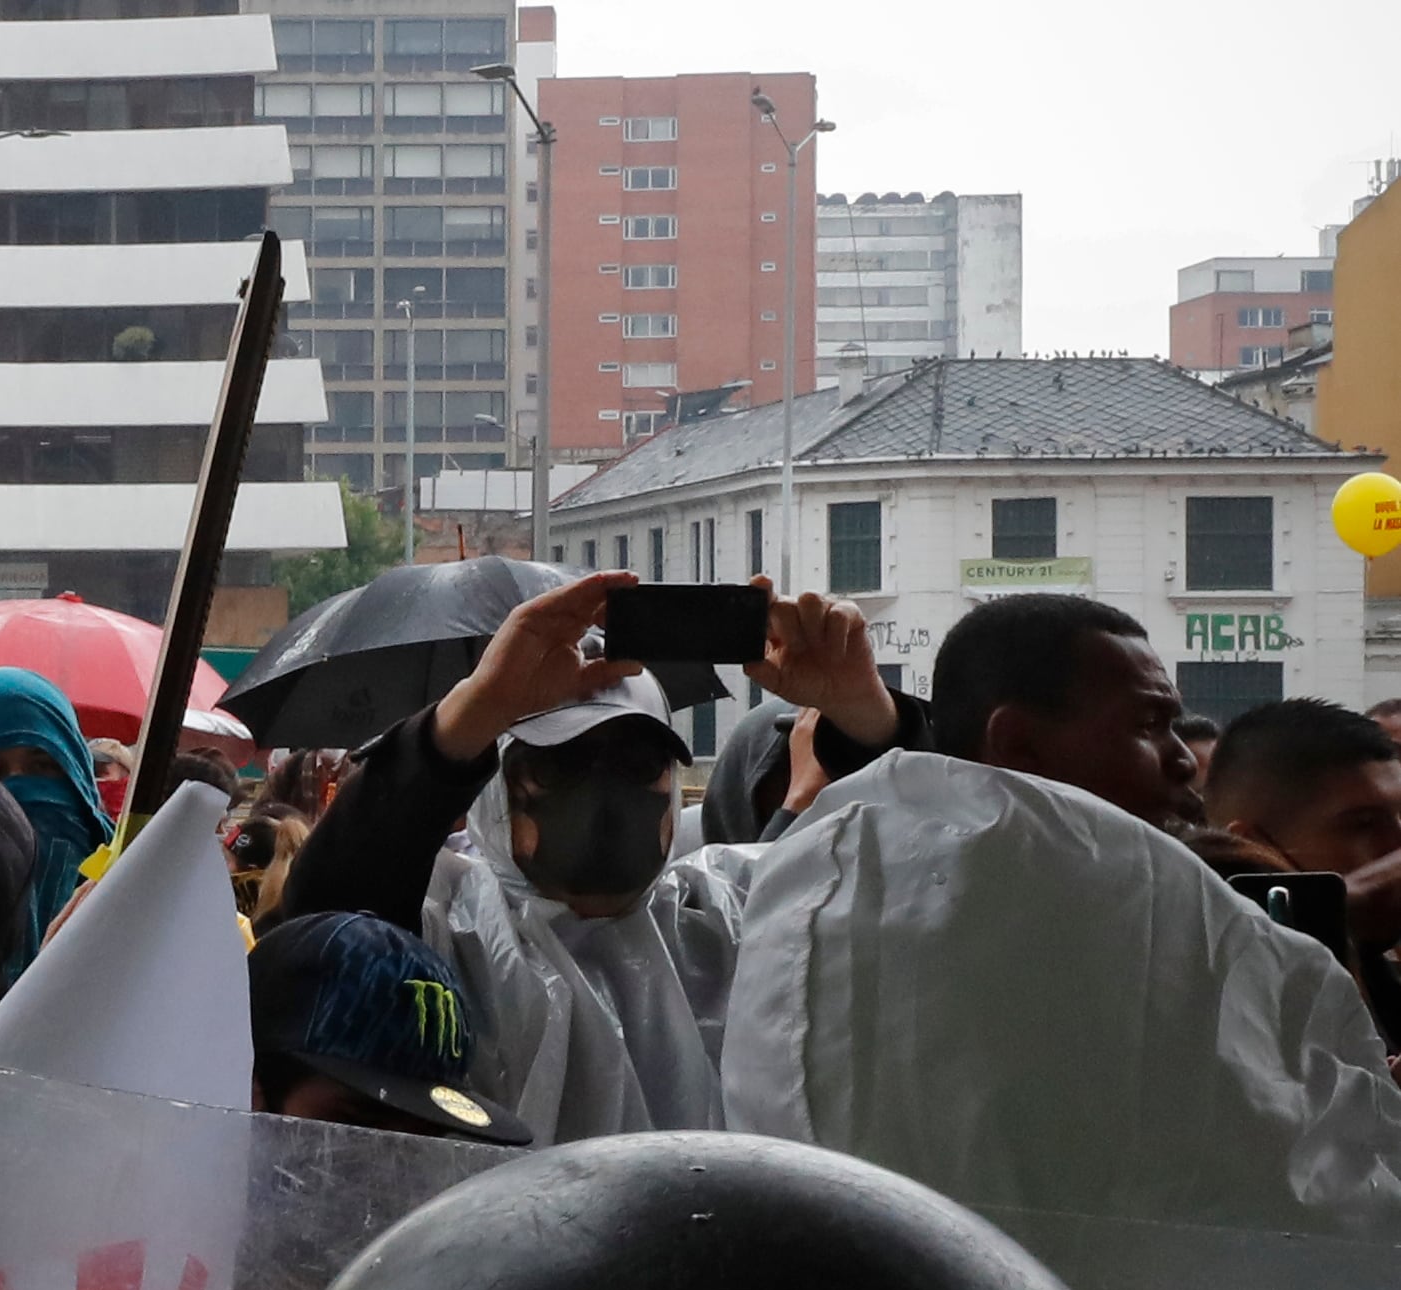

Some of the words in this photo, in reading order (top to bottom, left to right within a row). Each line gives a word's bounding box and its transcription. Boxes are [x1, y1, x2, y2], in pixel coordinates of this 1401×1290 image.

[966, 565, 1035, 578] CENTURY
[1039, 565, 1053, 577] 21
[1186, 614, 1284, 651] ACAB
